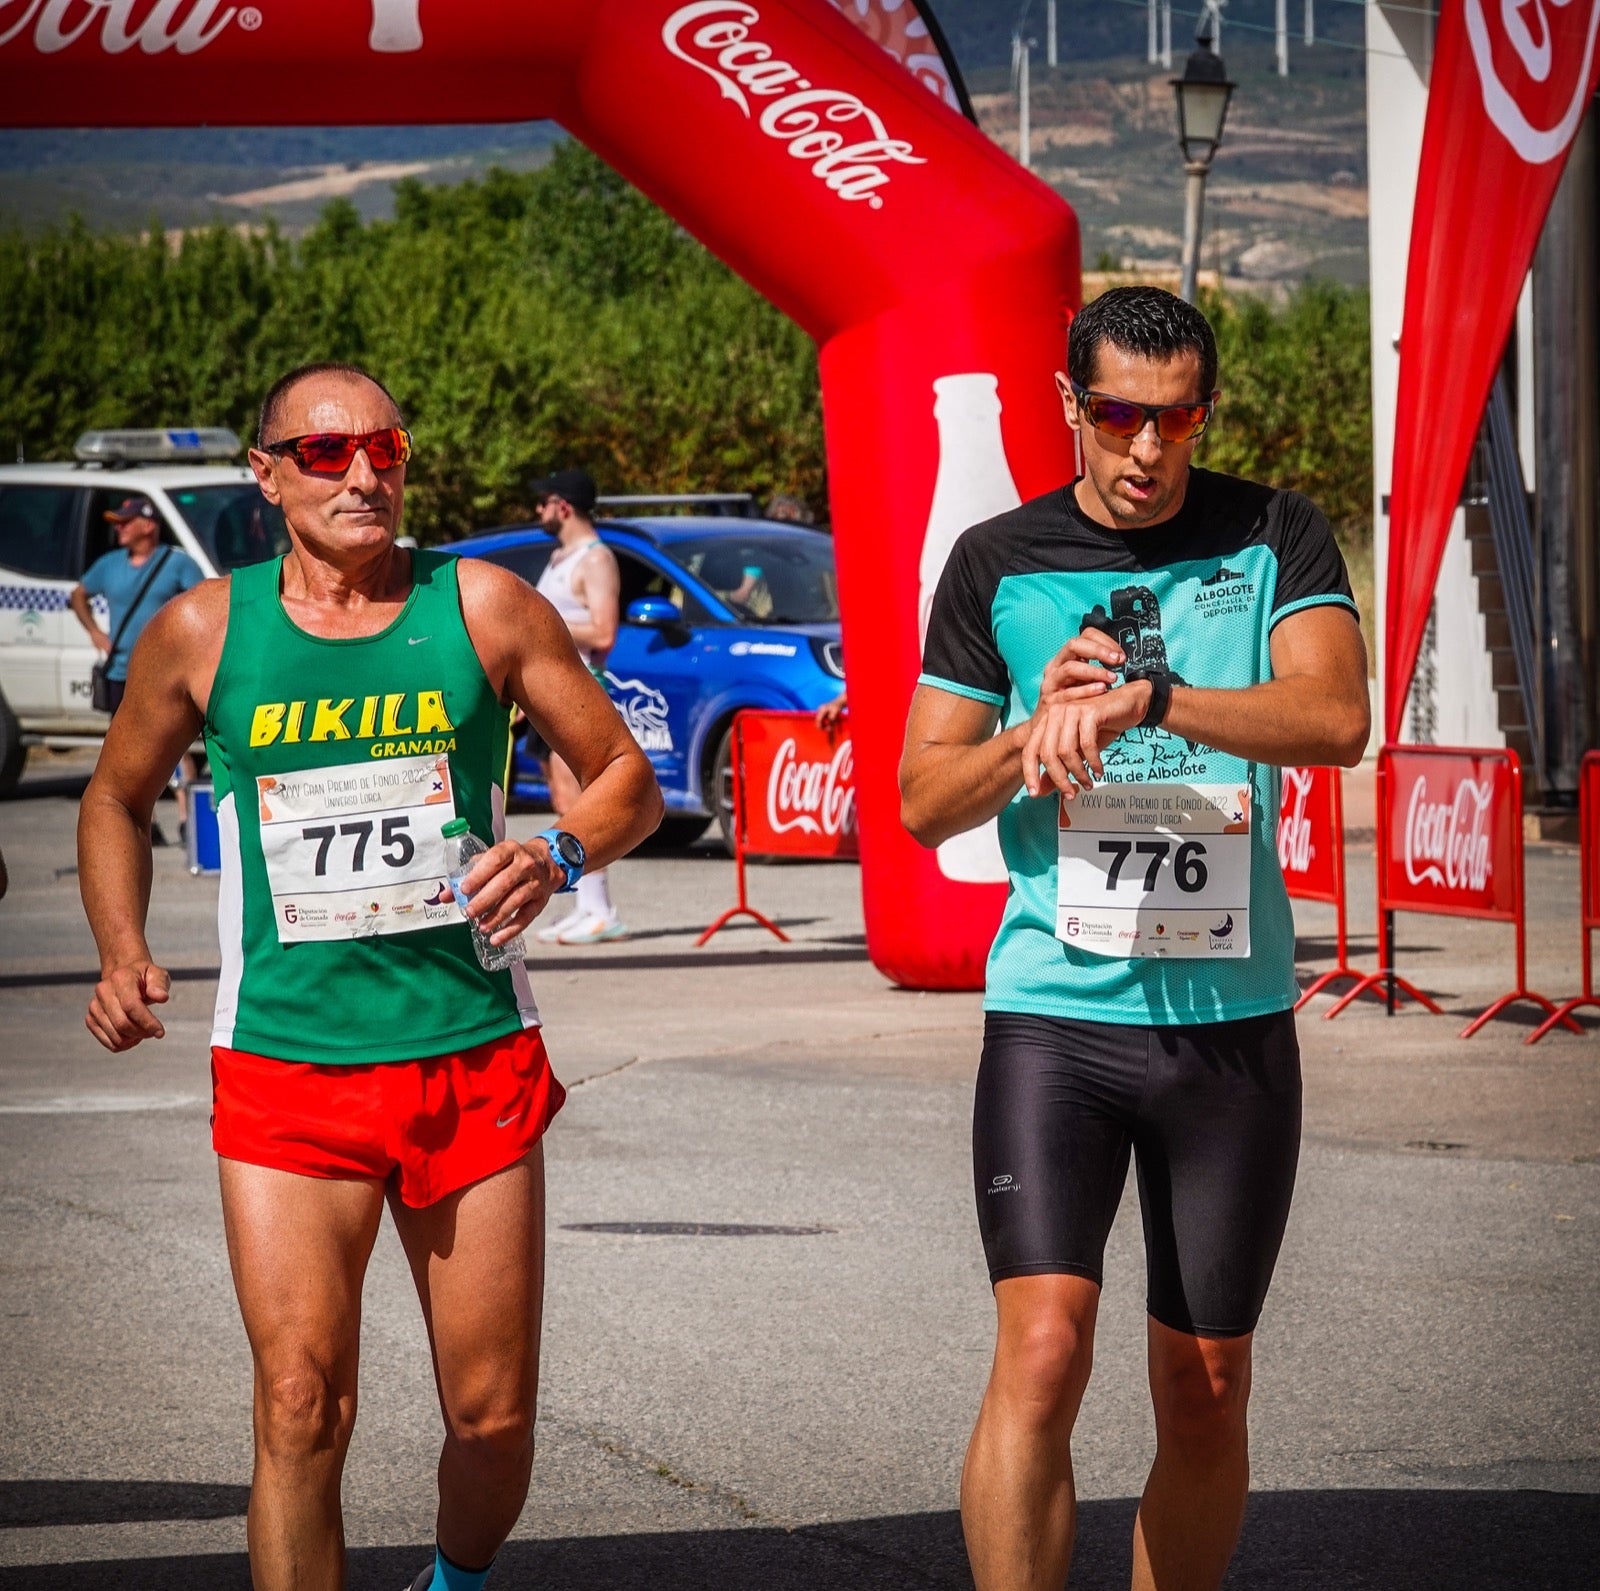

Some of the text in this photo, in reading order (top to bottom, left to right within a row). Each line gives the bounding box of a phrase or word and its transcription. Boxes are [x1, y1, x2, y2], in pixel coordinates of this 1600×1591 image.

[662, 0, 928, 201] Coca-Cola
[1194, 584, 1254, 603] ALBOLOTE
[1203, 604, 1249, 618] DEPORTES
[249, 690, 455, 748] BIKILA
[370, 737, 457, 758] GRANADA
[303, 782, 325, 797] GRAN
[327, 777, 358, 795] PREMIO
[359, 777, 371, 790] DE
[372, 774, 399, 788] FONDO
[401, 769, 426, 785] 2022
[1125, 770, 1144, 783] de
[1147, 764, 1207, 781] Albolote
[324, 793, 382, 809] UNIVERSO LORCA
[1080, 795, 1228, 811] XXXV GRAN PREMIO DE FONDO 2022
[1123, 812, 1182, 825] UNIVERSO LORCA
[302, 815, 415, 877] 775
[1098, 840, 1208, 893] 776
[423, 905, 449, 920] Lorca
[1208, 934, 1233, 950] Lorca
